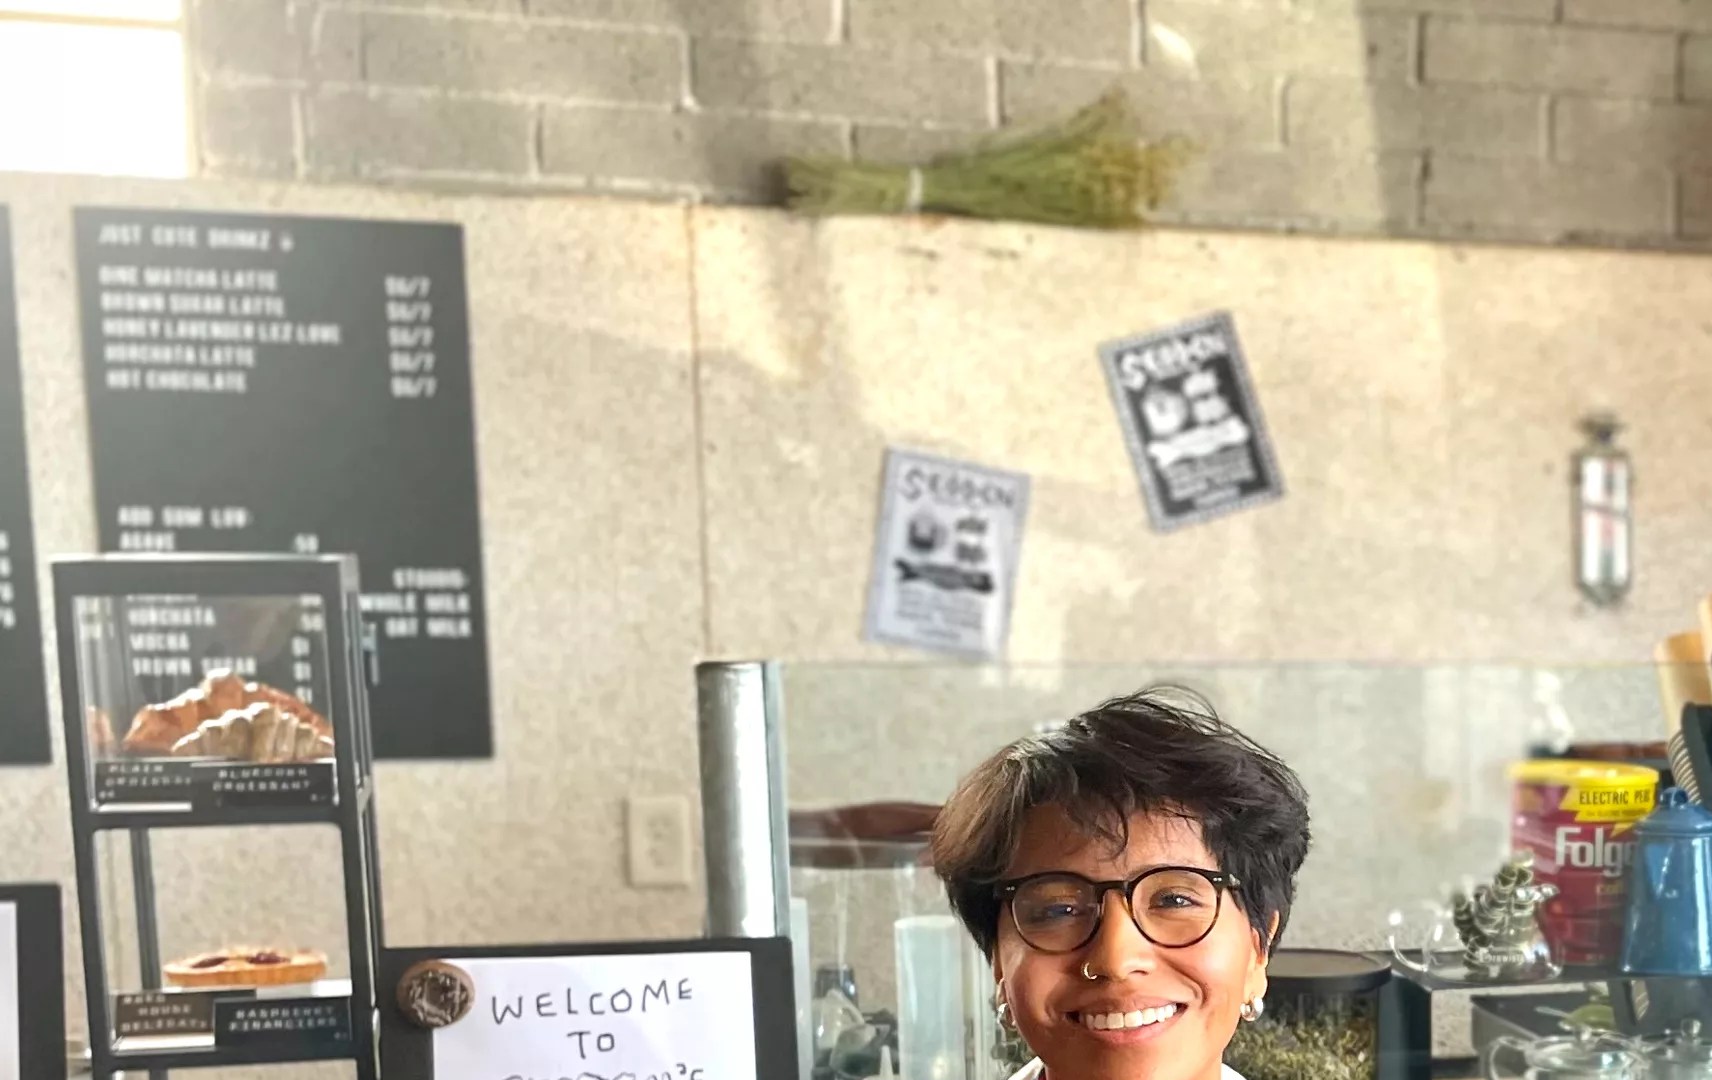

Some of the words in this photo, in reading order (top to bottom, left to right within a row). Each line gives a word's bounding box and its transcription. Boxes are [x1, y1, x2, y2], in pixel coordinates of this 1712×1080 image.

[1579, 791, 1629, 805] ELECTRIC
[1555, 826, 1637, 878] Folg
[491, 977, 693, 1026] WELCOME
[567, 1030, 616, 1060] TO
